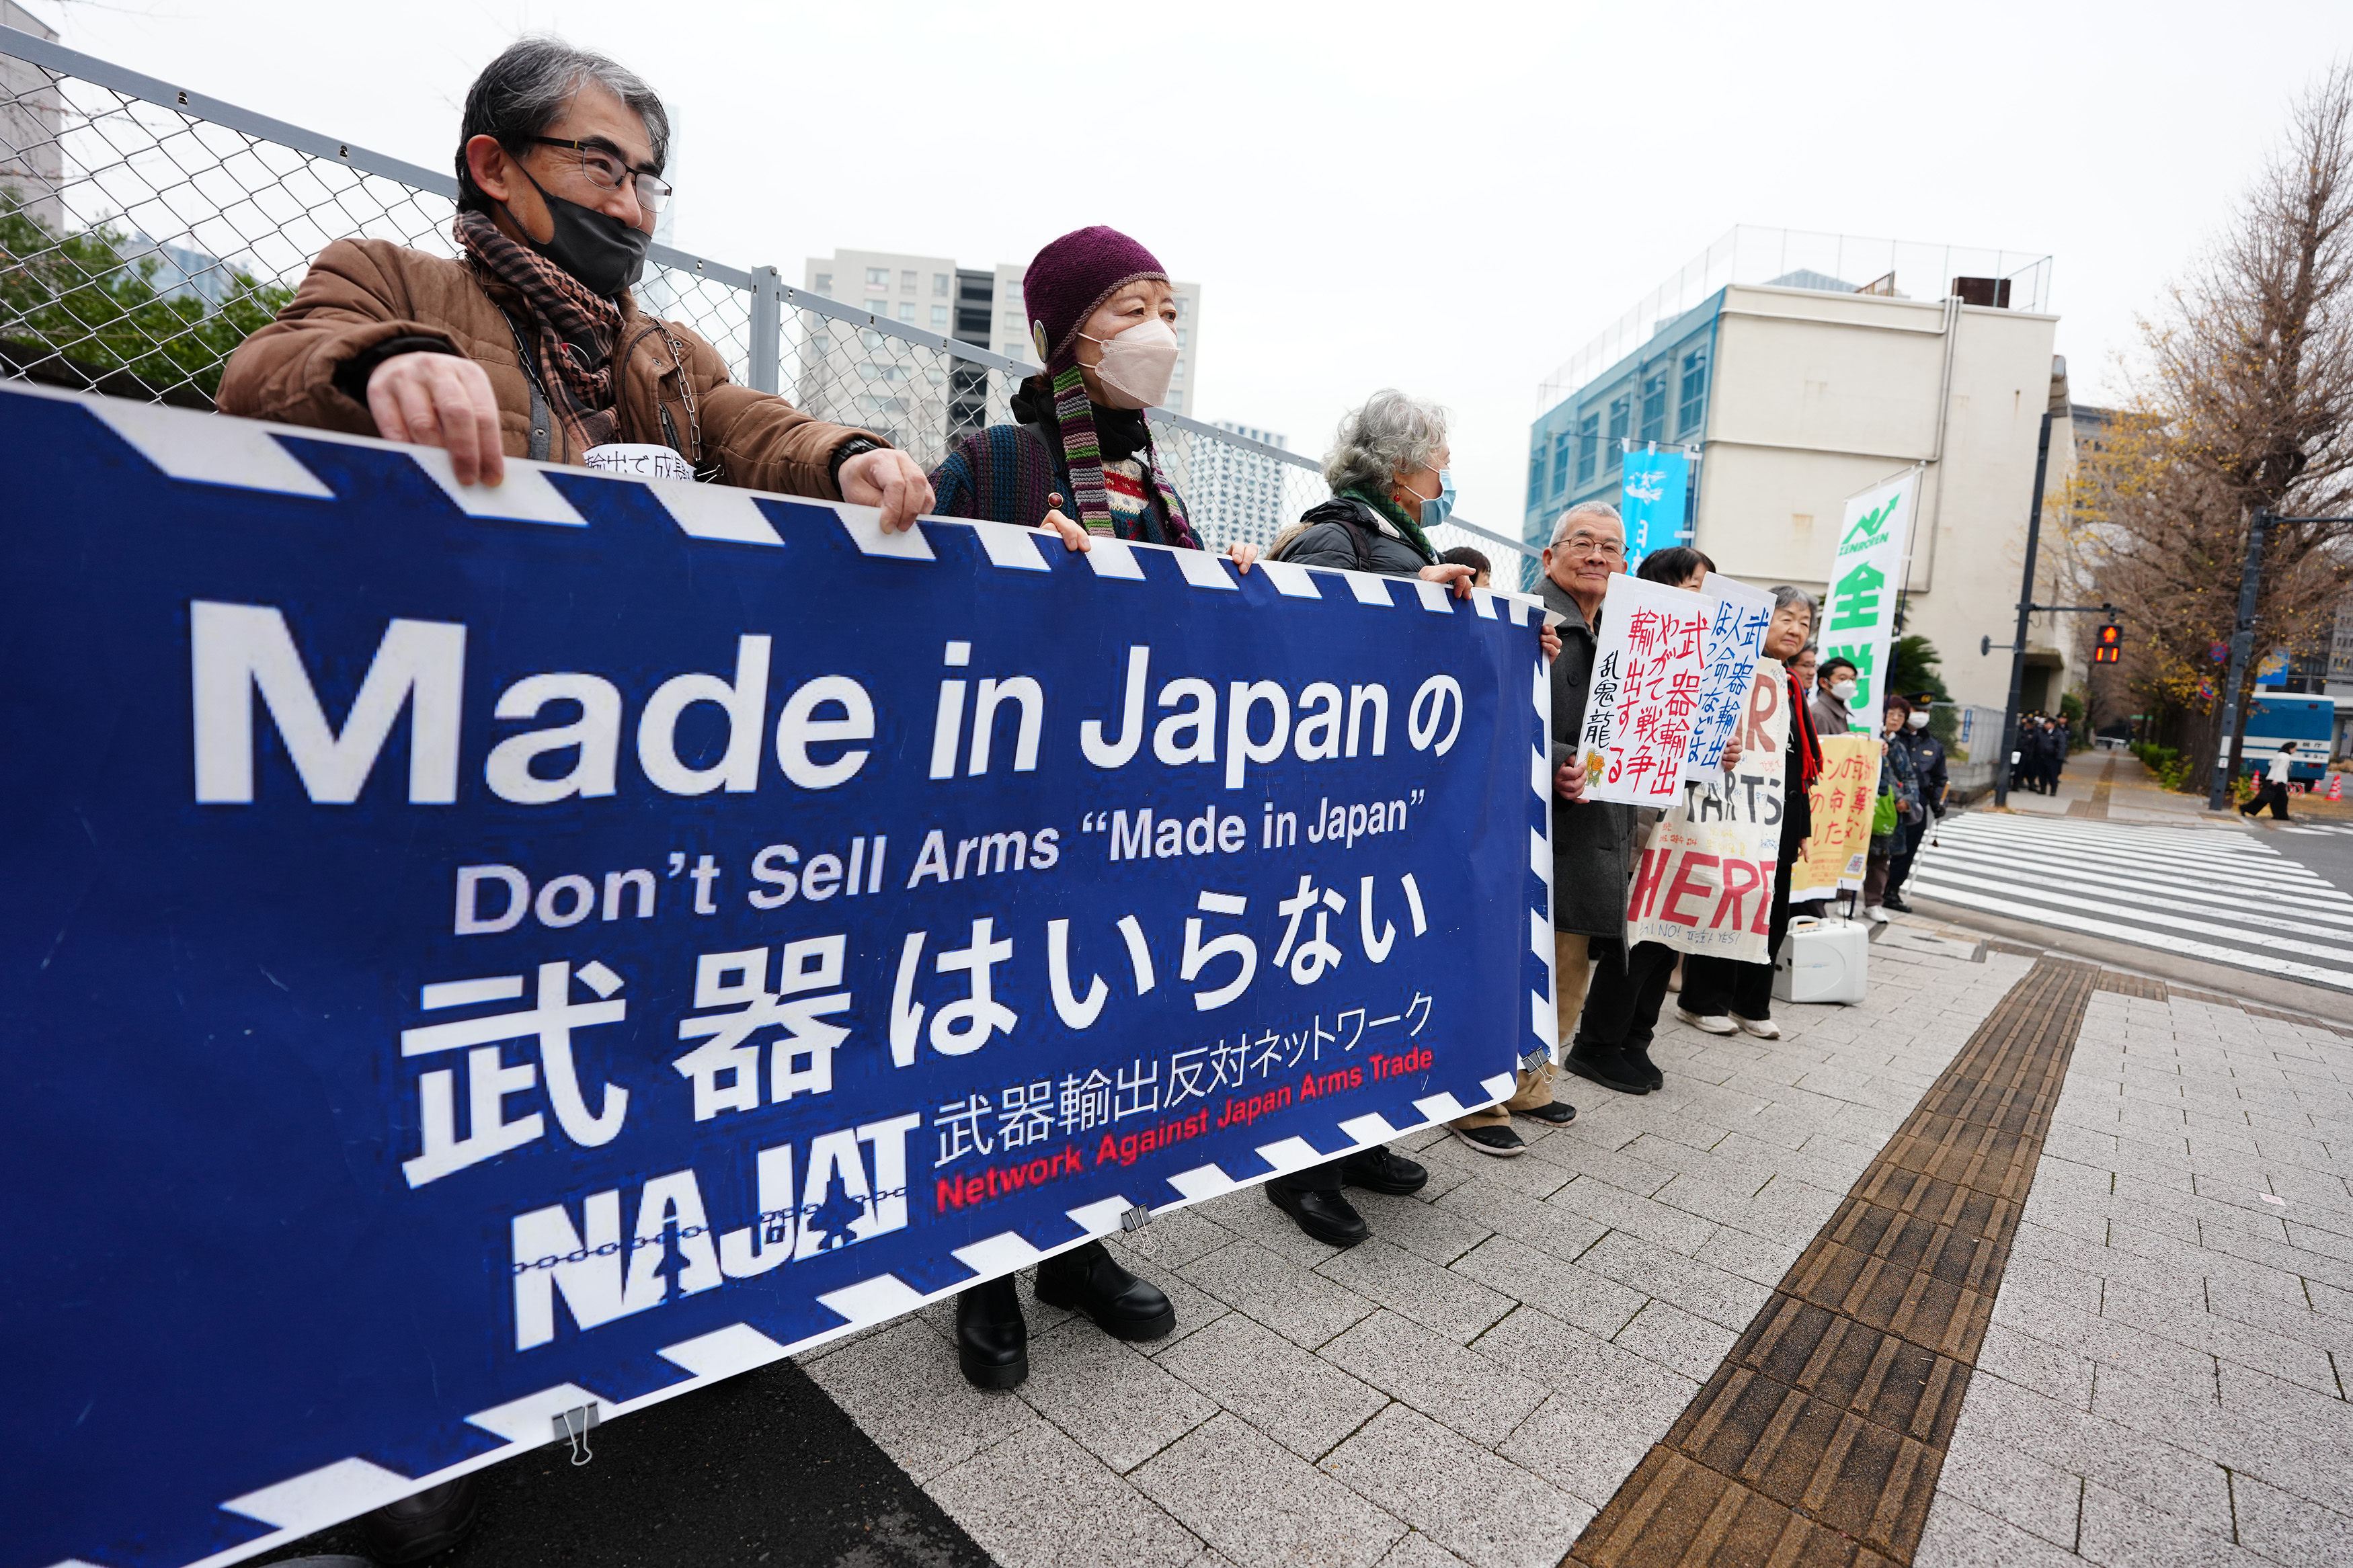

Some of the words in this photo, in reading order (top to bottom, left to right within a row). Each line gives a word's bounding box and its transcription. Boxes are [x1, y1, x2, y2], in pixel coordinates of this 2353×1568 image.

[190, 600, 876, 804] Made
[929, 641, 1043, 780] in
[1080, 645, 1389, 790] Japan
[1408, 674, 1464, 757] の
[1584, 649, 1622, 749] 乱鬼龍
[1607, 606, 1660, 784] 輸出する
[1626, 612, 1680, 794] やがて戦争
[1649, 610, 1712, 797] 武器輸出
[1700, 606, 1770, 770] 武器輸出
[454, 853, 720, 935] Don’t
[748, 836, 886, 909] Sell
[907, 827, 1060, 889] Arms
[1082, 805, 1246, 862] “Made
[1263, 802, 1297, 849] in
[1308, 789, 1425, 850] Japan”
[1627, 848, 1777, 936] HERE
[1659, 923, 1681, 938] NO!
[1718, 931, 1741, 945] YES!
[400, 873, 1428, 1189] 武器はいらない
[933, 991, 1433, 1169] 武器輸出反対ネットワーク
[936, 1145, 1083, 1212] Network
[1096, 1108, 1209, 1167] Against
[1217, 1086, 1291, 1128] Japan
[1300, 1067, 1363, 1102] Arms
[1369, 1046, 1433, 1080] Trade
[512, 1112, 920, 1353] NAJAT
